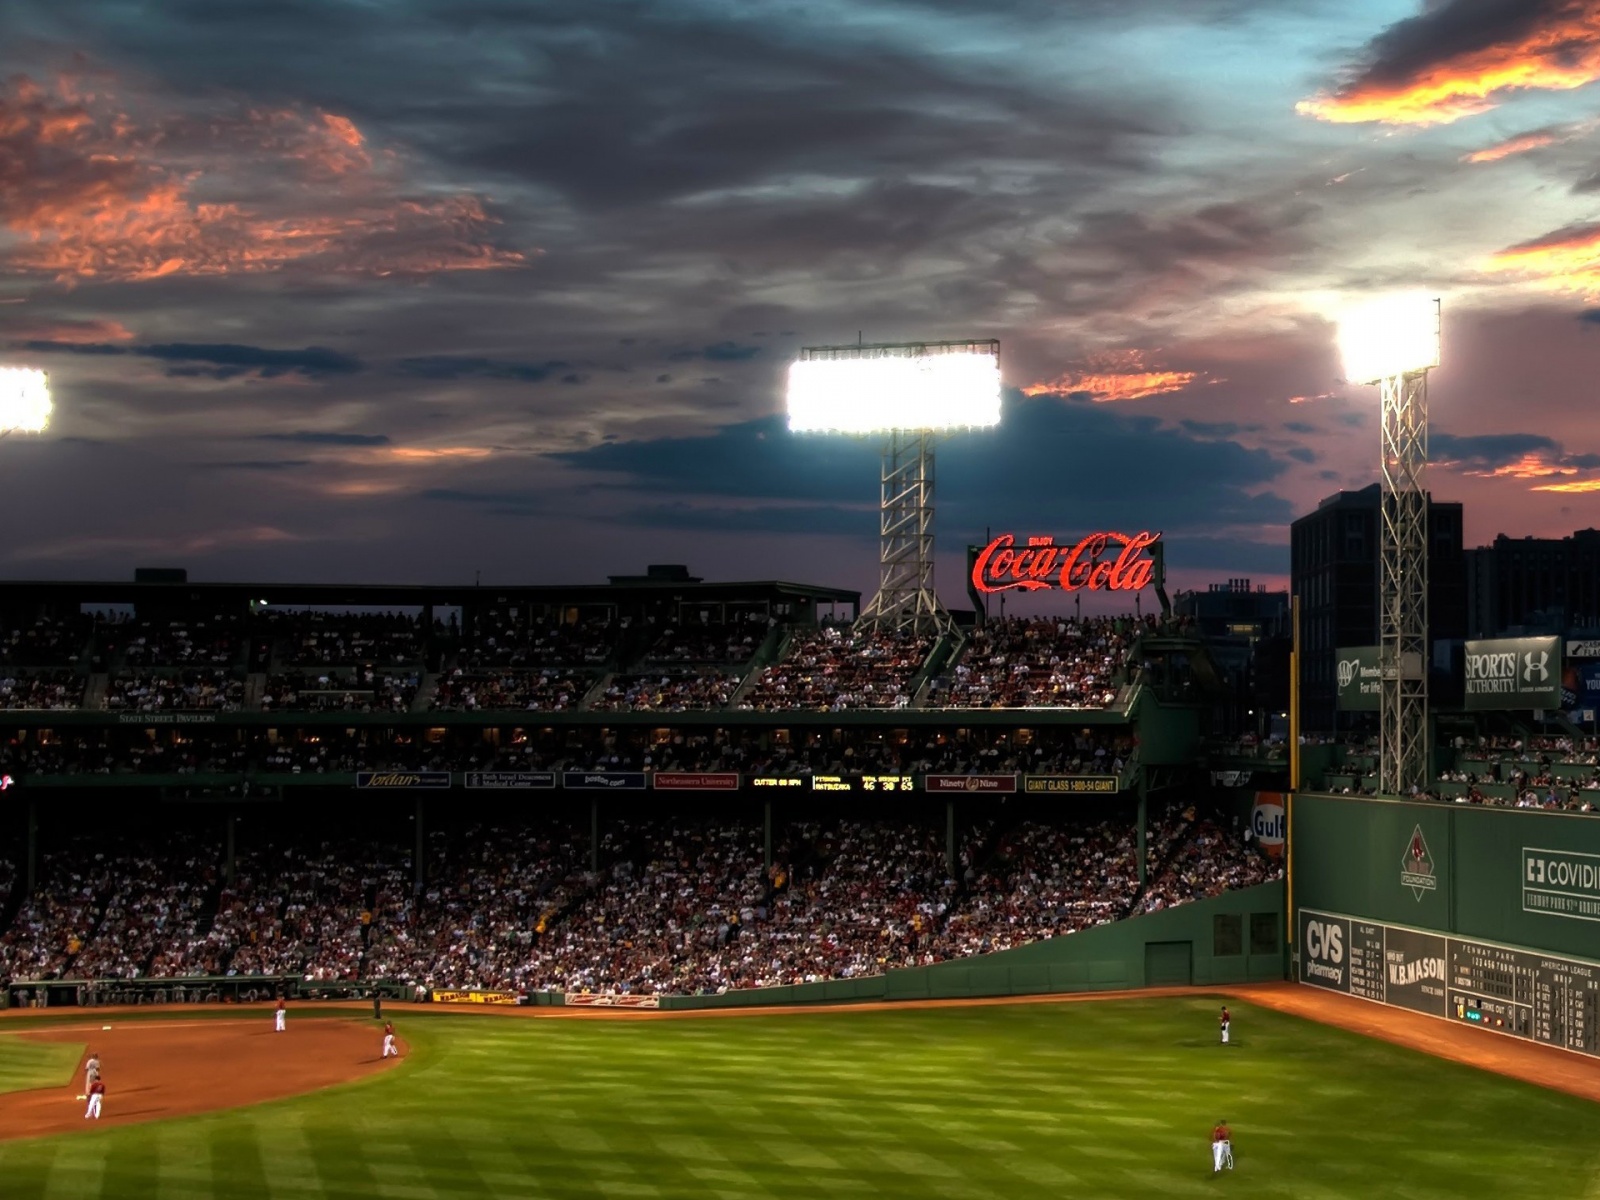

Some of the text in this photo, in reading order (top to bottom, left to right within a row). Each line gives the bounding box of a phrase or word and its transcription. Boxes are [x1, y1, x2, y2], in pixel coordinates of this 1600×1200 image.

[1029, 536, 1054, 547] ENJOY
[971, 531, 1162, 592] Coca-Cola
[1465, 653, 1515, 678] SPORTS
[1360, 682, 1369, 693] For
[120, 714, 215, 723] STATE STREET PAVILION
[365, 773, 420, 787] Jordan's
[585, 775, 625, 787] boston.com
[658, 777, 735, 787] Northeastern University
[940, 778, 999, 789] Ninety Nine
[1028, 780, 1047, 790] GIANT
[1048, 780, 1070, 790] GLASS
[1095, 780, 1114, 791] GIANT
[1526, 893, 1549, 908] FENWAY
[1550, 896, 1565, 910] PARK
[1306, 920, 1343, 964] CVS
[1462, 944, 1515, 962] FENWAY PARK
[1306, 959, 1342, 985] pharmacy
[1541, 960, 1592, 978] AMERICAN LEAGUE
